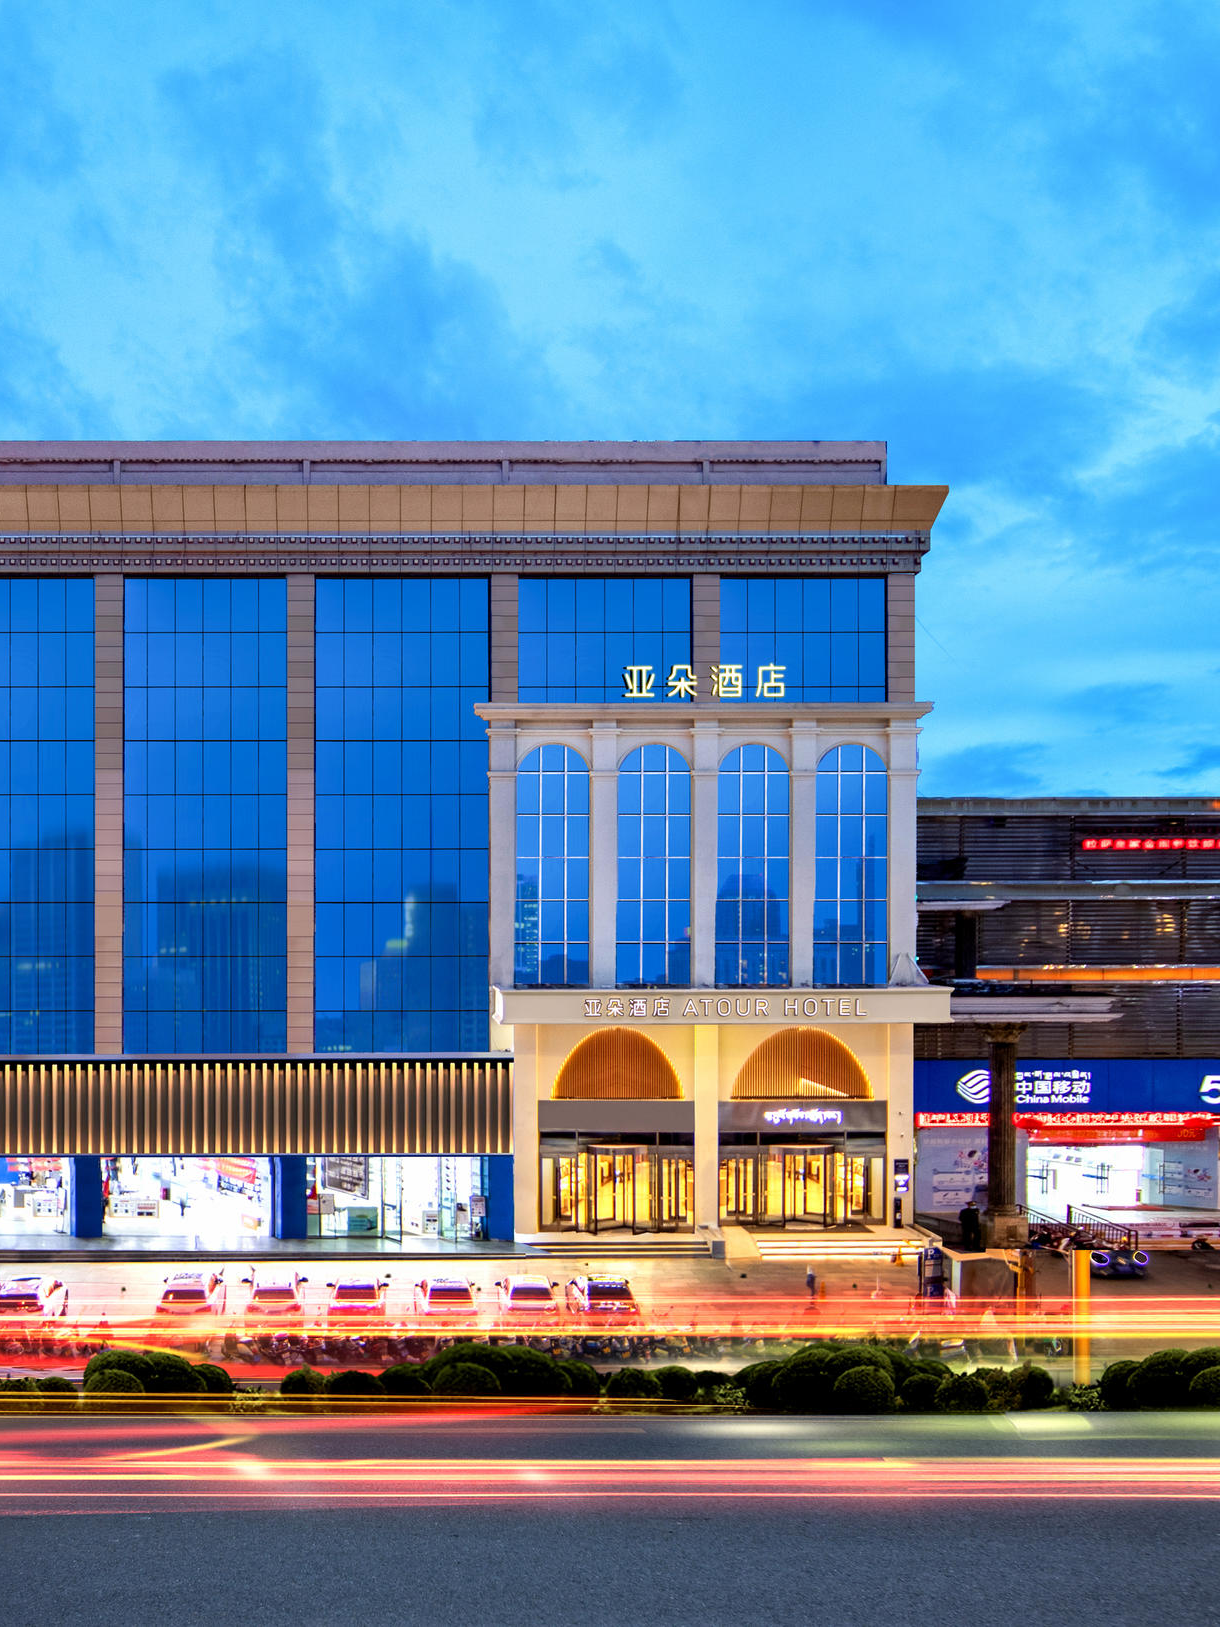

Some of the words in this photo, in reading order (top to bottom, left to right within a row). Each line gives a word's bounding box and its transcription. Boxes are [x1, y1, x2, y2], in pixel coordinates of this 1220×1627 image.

[623, 663, 787, 698] 亚朵酒店
[584, 998, 670, 1017] 亚朵酒店
[682, 998, 770, 1017] ATOUR
[783, 998, 868, 1017] HOTEL
[1013, 1080, 1092, 1095] 中国移动
[1013, 1094, 1050, 1104] China
[1051, 1094, 1091, 1104] Mobile
[927, 1248, 935, 1259] P
